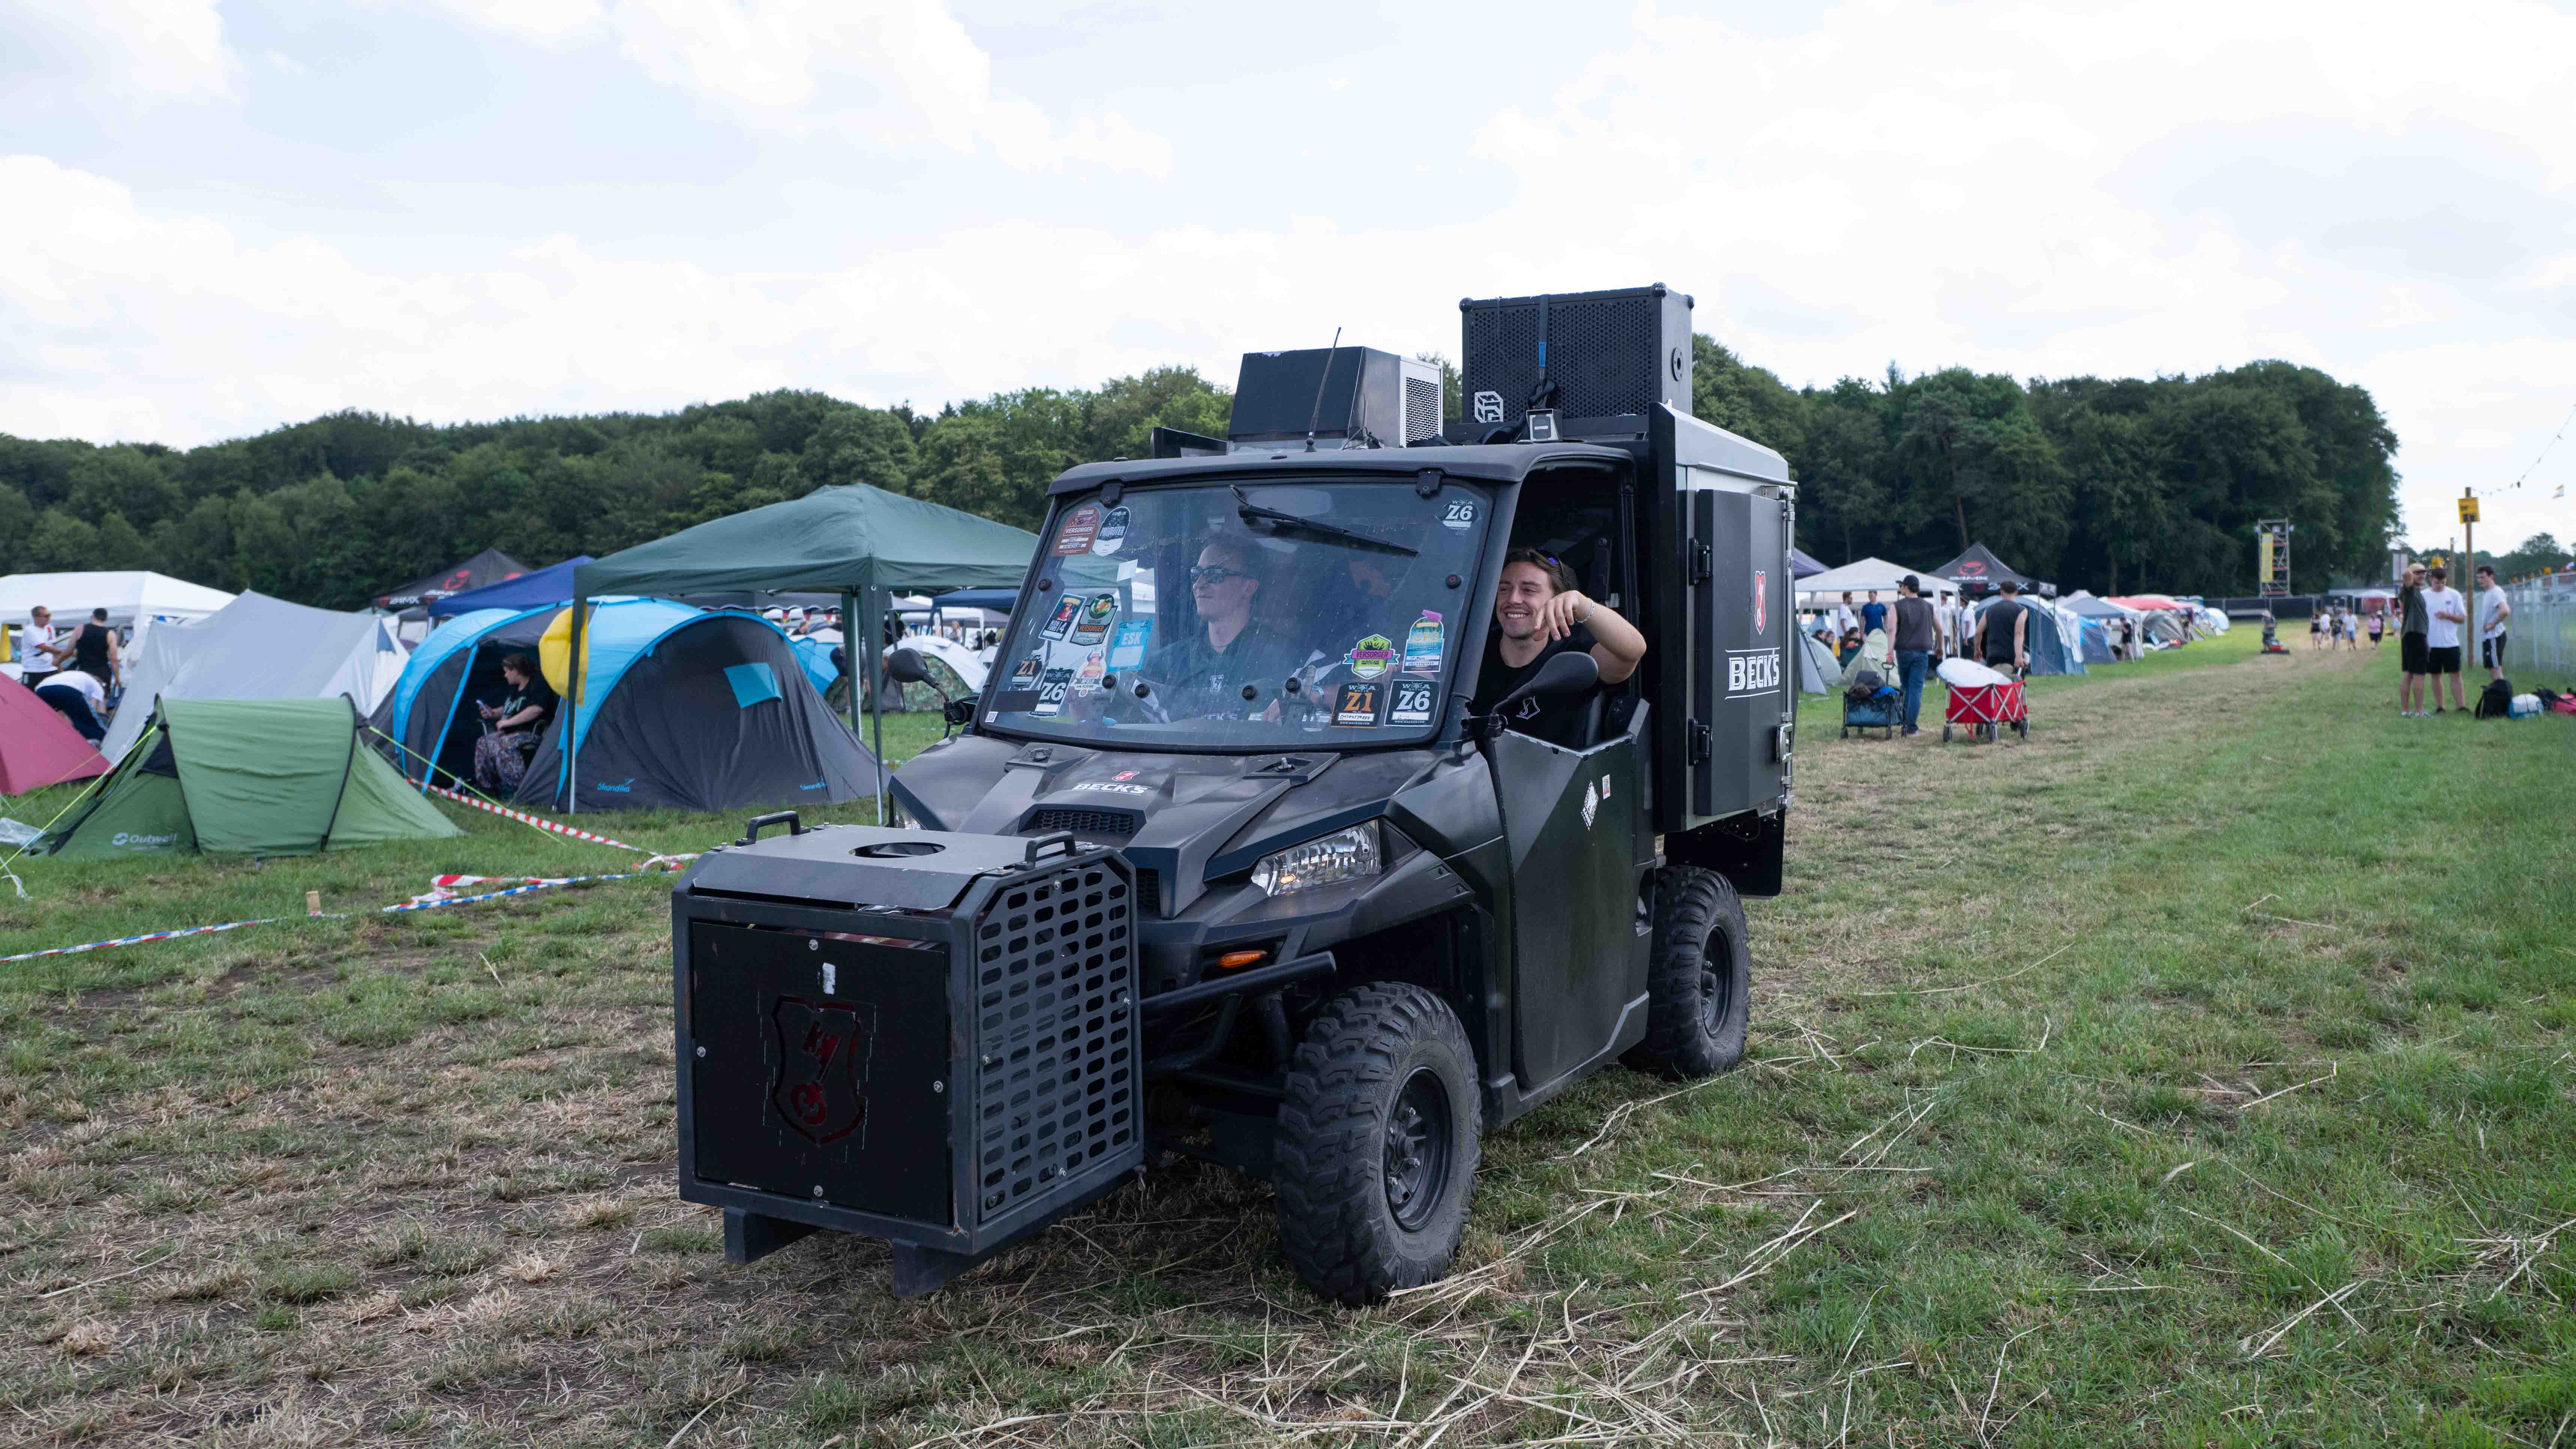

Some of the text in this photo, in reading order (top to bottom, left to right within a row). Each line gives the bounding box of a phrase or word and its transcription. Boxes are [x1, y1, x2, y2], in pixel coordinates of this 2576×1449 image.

[1445, 504, 1473, 520] Z6
[1100, 526, 1125, 537] PROMOTER
[1122, 631, 1143, 645] ESK
[1413, 632, 1439, 642] CP2
[1016, 660, 1037, 675] Z1
[1728, 648, 1779, 691] BECK'S
[1039, 682, 1067, 701] Z6
[1344, 692, 1373, 712] Z1
[1396, 690, 1431, 711] Z6
[1071, 783, 1148, 794] BECK'S
[130, 834, 177, 843] Outwell
